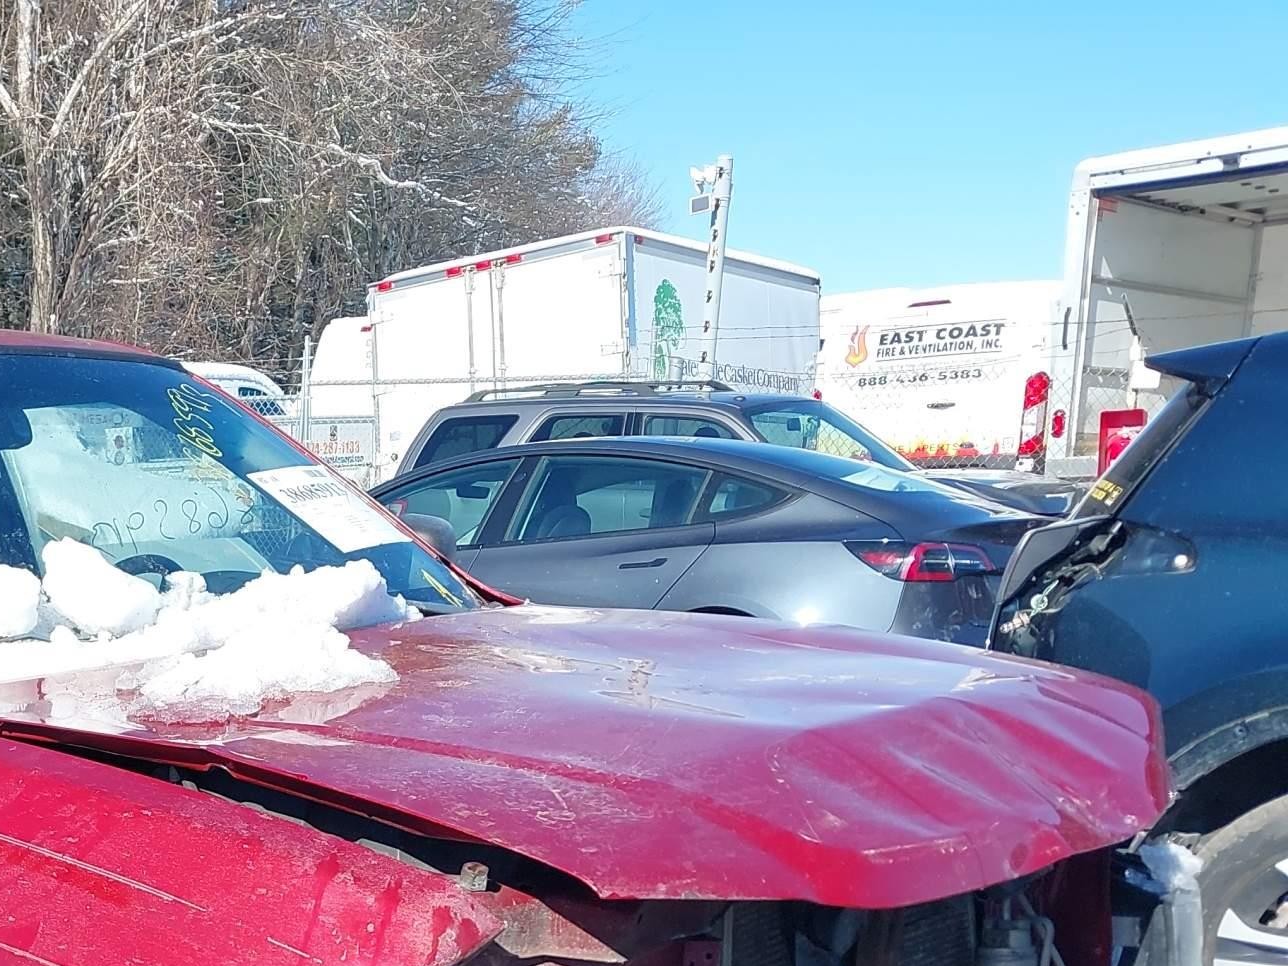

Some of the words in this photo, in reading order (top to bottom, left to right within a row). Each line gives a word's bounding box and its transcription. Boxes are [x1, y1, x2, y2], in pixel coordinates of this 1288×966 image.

[879, 330, 927, 346] EAST
[936, 323, 1005, 340] COAST
[876, 347, 896, 358] FIRE
[899, 346, 905, 356] &
[908, 340, 977, 355] VENTILATION,
[981, 339, 1002, 349] INC.
[724, 363, 756, 384] Casket
[756, 368, 798, 393] Company
